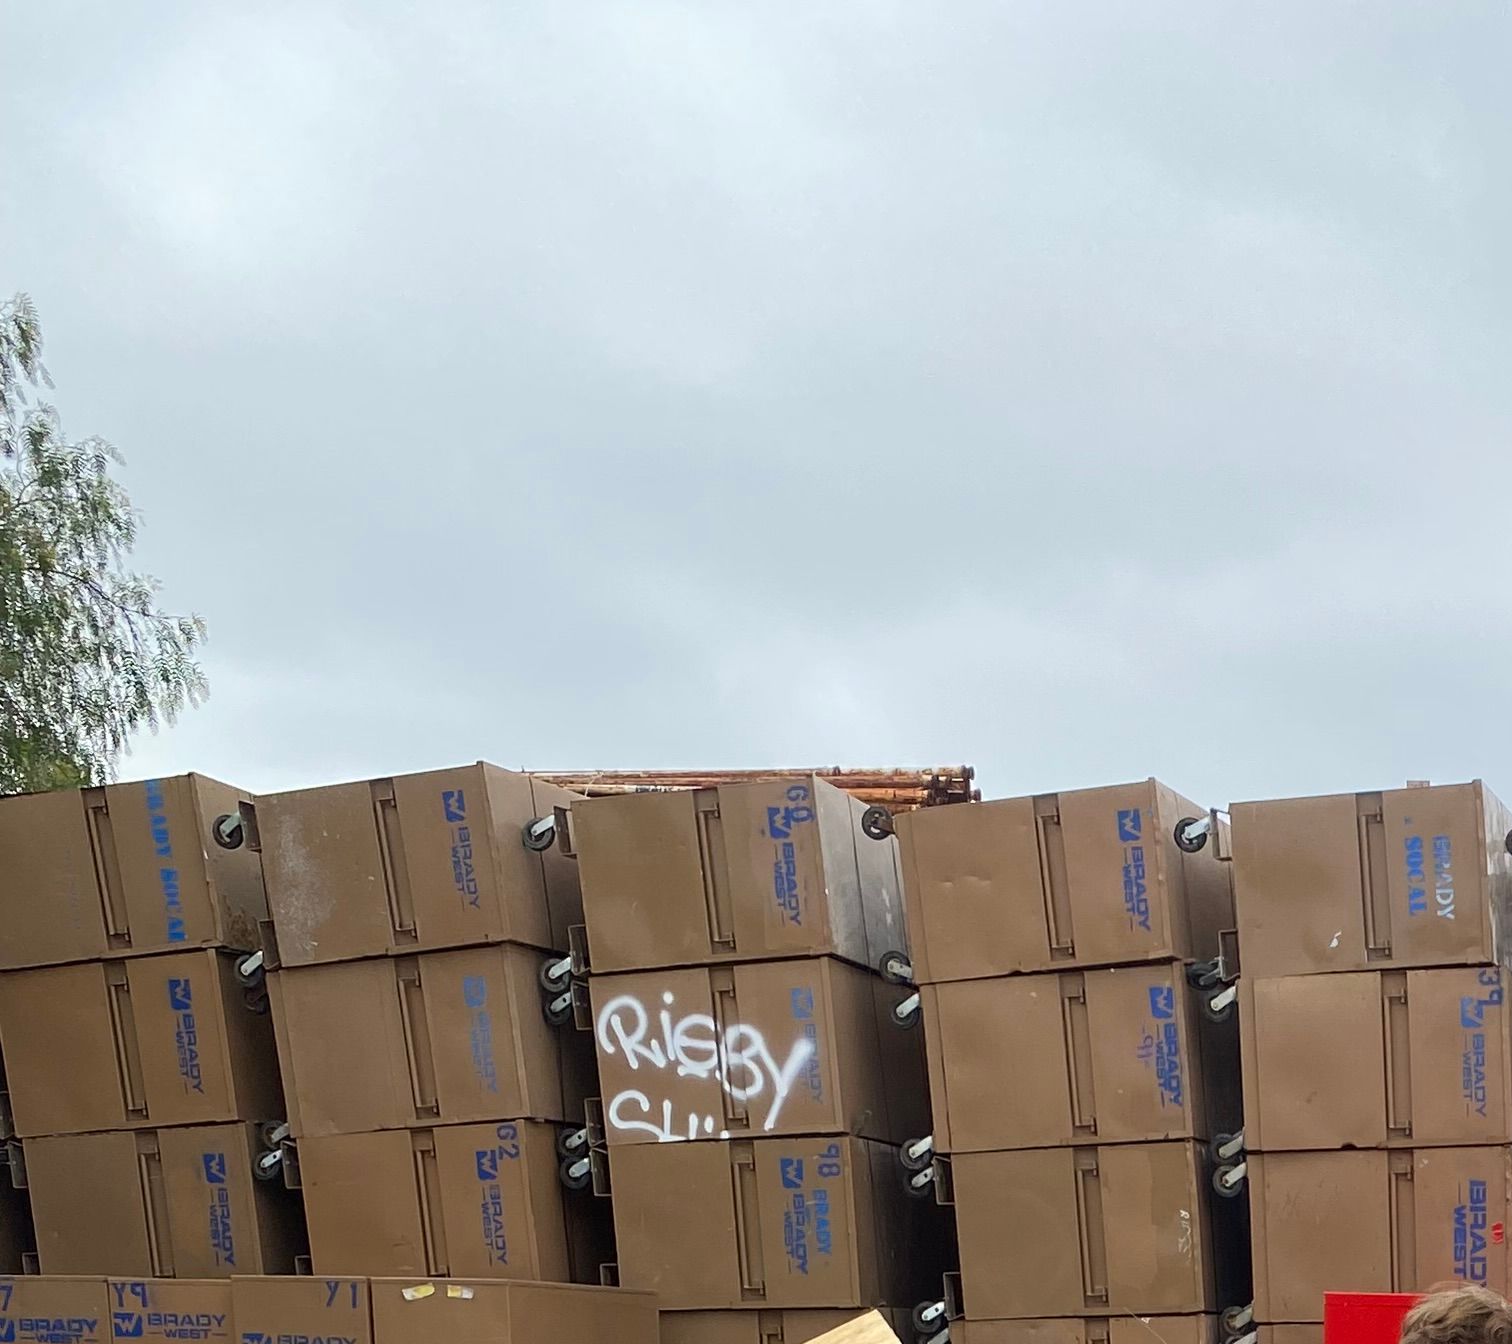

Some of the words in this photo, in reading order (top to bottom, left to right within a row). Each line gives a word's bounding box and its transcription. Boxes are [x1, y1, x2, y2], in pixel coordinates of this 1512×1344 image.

[452, 846, 466, 895] WEST
[458, 826, 481, 910] BRADY
[774, 860, 788, 910] WEST
[782, 842, 802, 926] BRADY
[1122, 863, 1136, 915] WEST
[1131, 846, 1151, 932] BRADY
[1404, 836, 1427, 916] SOCAL
[175, 1031, 190, 1077] WEST
[182, 1014, 205, 1094] BRADY
[1155, 1041, 1169, 1091] WEST
[1164, 1023, 1183, 1107] BRADY
[1462, 1051, 1474, 1102] WEST
[1472, 1034, 1487, 1118] BRADY
[210, 1204, 221, 1249] WEST
[217, 1187, 236, 1266] BRADY
[481, 1202, 495, 1249] WEST
[489, 1184, 508, 1265] BRADY
[784, 1211, 795, 1258] WEST
[793, 1193, 808, 1275] BRADY
[1454, 1205, 1467, 1280] WEST
[1470, 1180, 1487, 1288] BRAD
[19, 1318, 97, 1334] BRADY
[35, 1334, 82, 1344] WEST
[147, 1313, 226, 1328] BRADY
[163, 1328, 211, 1340] WEST
